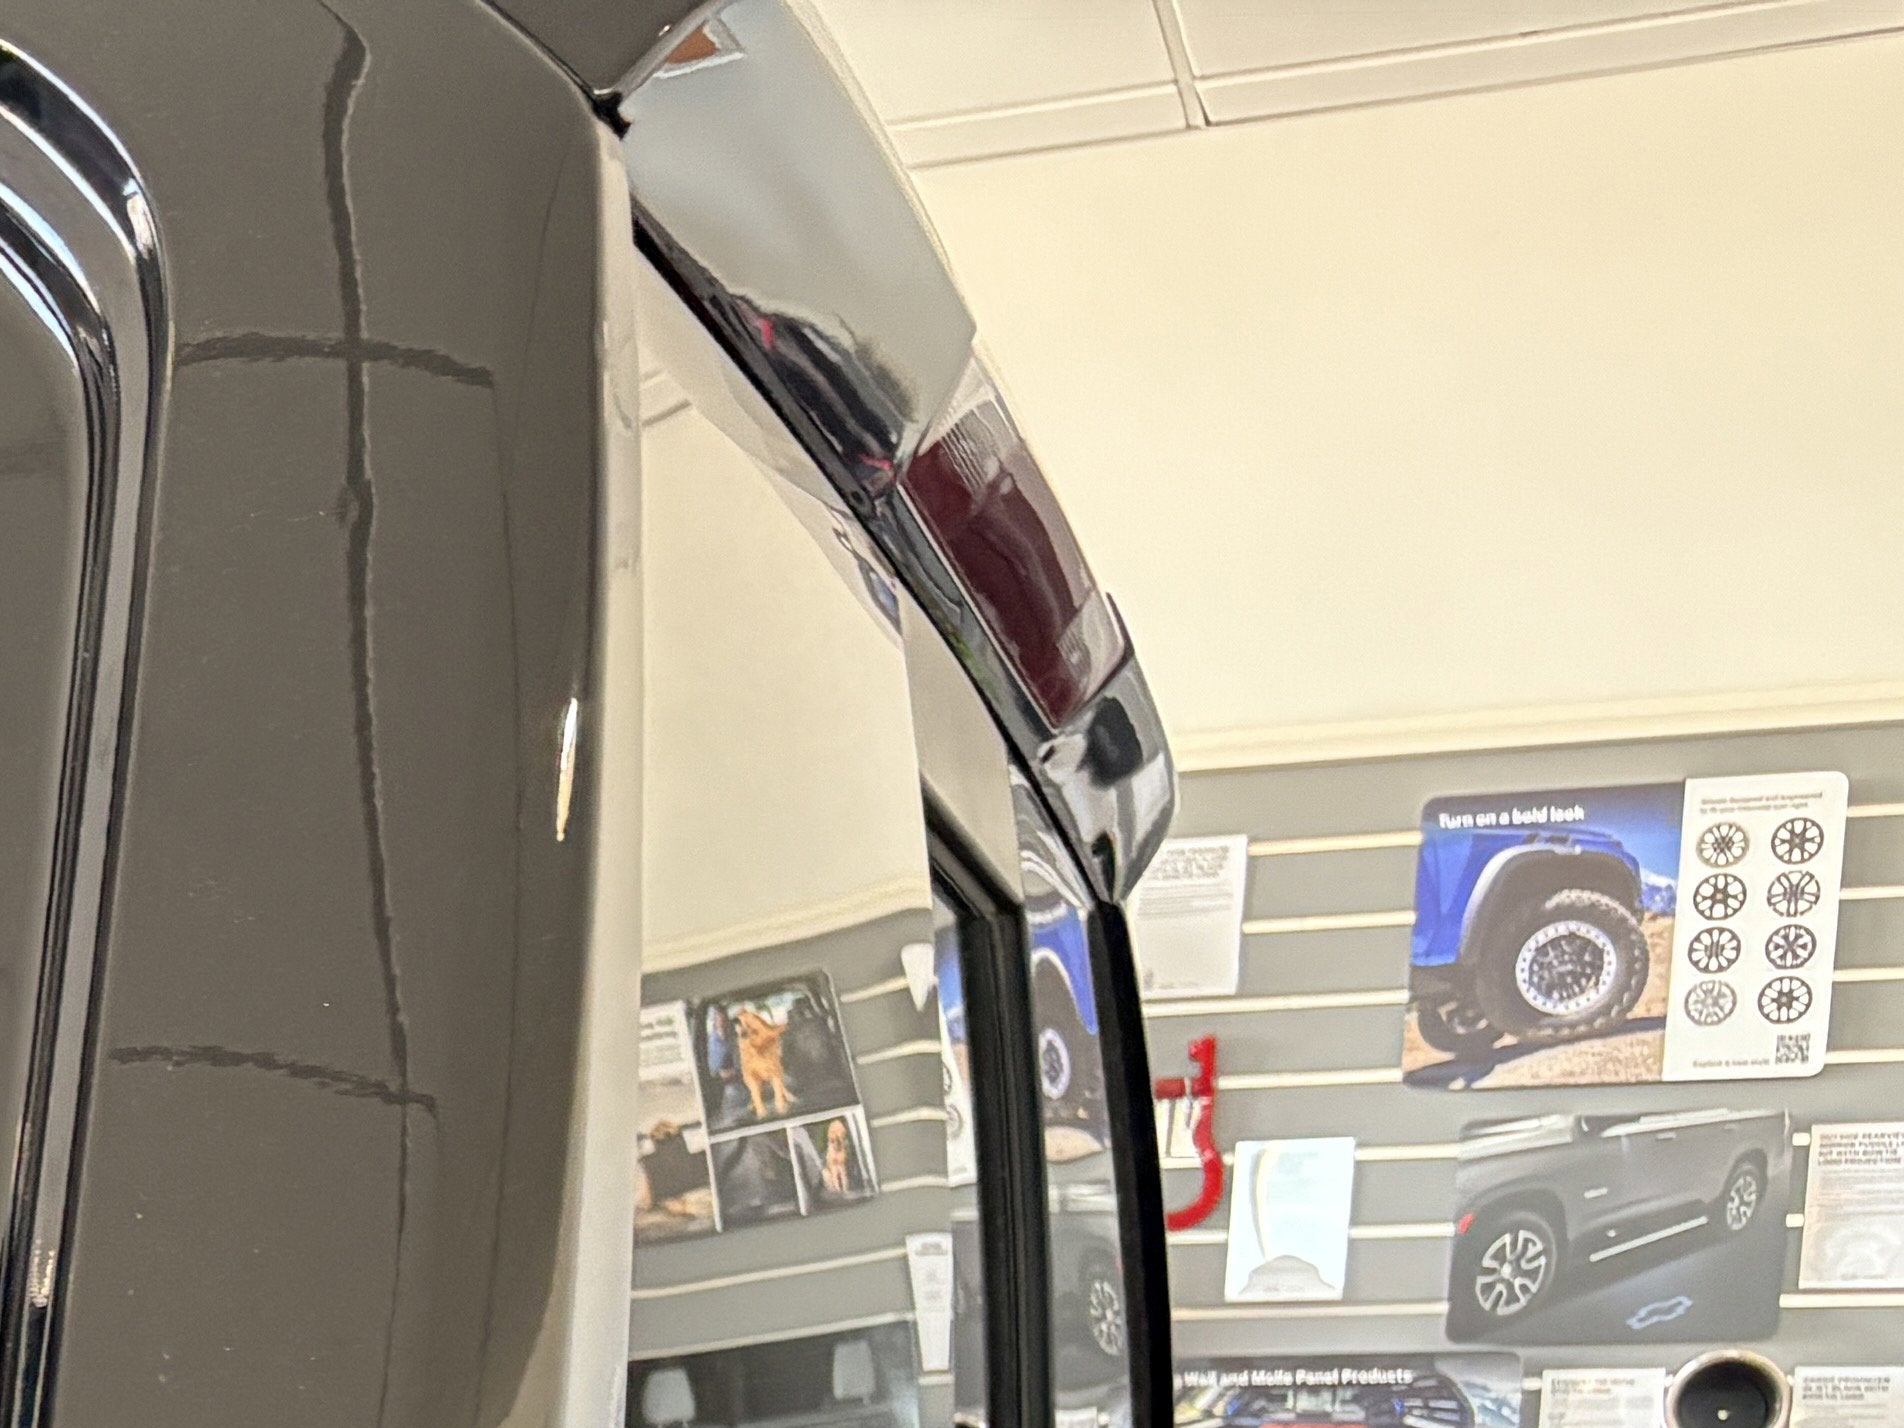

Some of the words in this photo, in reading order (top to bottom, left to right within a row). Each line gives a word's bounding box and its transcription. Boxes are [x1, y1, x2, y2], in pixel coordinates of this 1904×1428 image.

[1439, 812, 1474, 829] Turn
[1476, 812, 1497, 827] on
[1499, 812, 1510, 825] a
[1512, 806, 1547, 825] bold
[1341, 1368, 1414, 1385] Products
